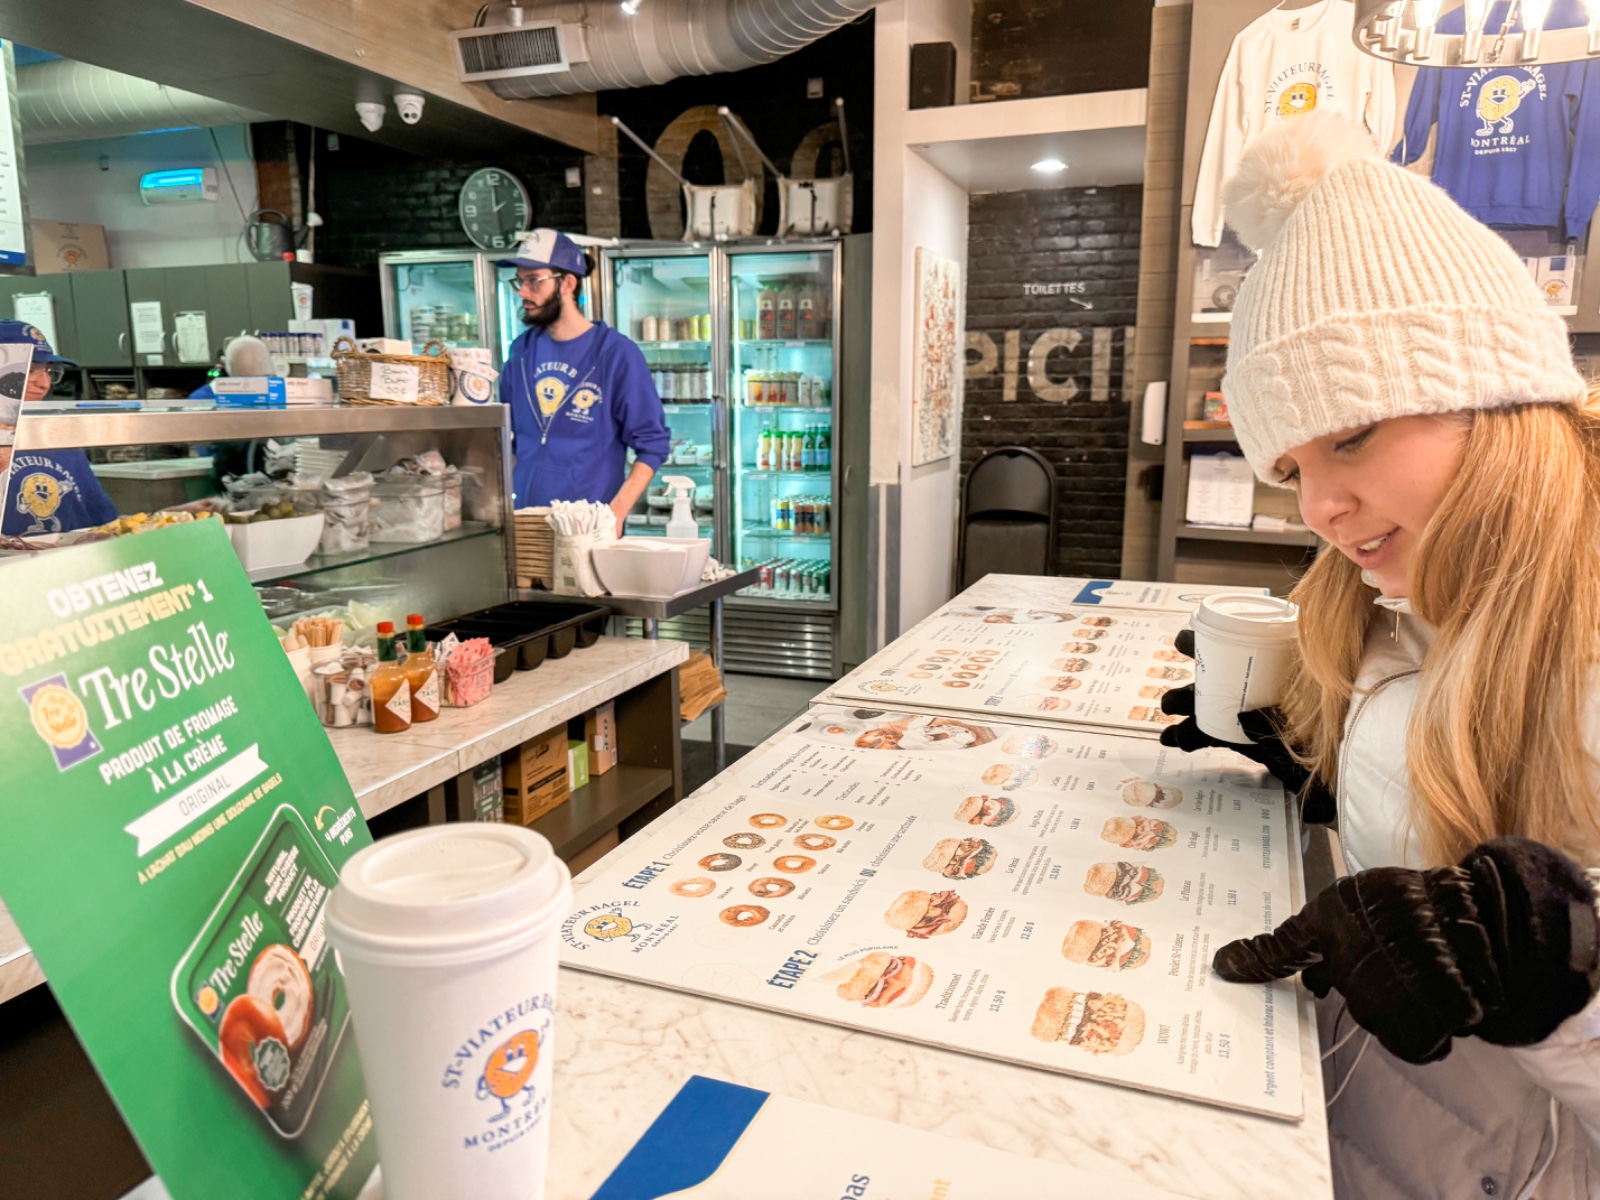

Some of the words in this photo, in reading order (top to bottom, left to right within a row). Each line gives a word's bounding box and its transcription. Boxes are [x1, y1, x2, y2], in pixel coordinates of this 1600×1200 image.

[1459, 67, 1496, 108] ST-VIA
[486, 174, 500, 186] 12
[465, 205, 477, 218] 9
[515, 205, 526, 216] 3
[492, 236, 505, 248] 6
[1023, 281, 1087, 296] TOILETTES
[534, 361, 568, 379] ATEUR
[47, 561, 164, 618] OBTENEZ
[196, 579, 213, 602] 1
[78, 666, 156, 730] Tre
[149, 621, 235, 699] Stelle
[99, 736, 164, 785] PRODUIT
[163, 725, 186, 749] DE
[183, 695, 238, 738] FROMAGE
[146, 767, 166, 794] À
[163, 760, 186, 785] LA
[184, 734, 228, 773] CRÈME
[178, 774, 232, 817] ORIGINAL
[191, 823, 215, 848] MOINS
[214, 813, 228, 831] UNE
[253, 785, 266, 801] DE
[262, 772, 283, 796] BAGELS
[622, 865, 665, 889] ÉTAPE
[806, 912, 840, 945] Choisissez
[834, 904, 848, 913] un
[842, 878, 868, 904] sandwich
[870, 841, 896, 867] choisissez
[560, 906, 591, 951] ST-VIATEUR
[590, 900, 641, 912] BAGEL
[971, 922, 988, 940] Viande
[979, 907, 996, 923] Fumée
[310, 918, 327, 952] ORIGI
[631, 914, 680, 953] MONTRÉAL
[209, 964, 239, 996] Tre
[229, 911, 264, 977] Stelle
[767, 957, 812, 989] ÉTAPE
[793, 949, 818, 959] 2
[935, 973, 962, 1009] Traditionnel
[989, 994, 1004, 1012] 13,50
[1263, 1003, 1274, 1027] Interac
[1264, 1027, 1275, 1036] et
[441, 996, 540, 1090] ST-VIATEUR
[1218, 1039, 1231, 1059] 13,50
[1264, 1035, 1275, 1070] comptant
[1263, 1070, 1278, 1097] Argent
